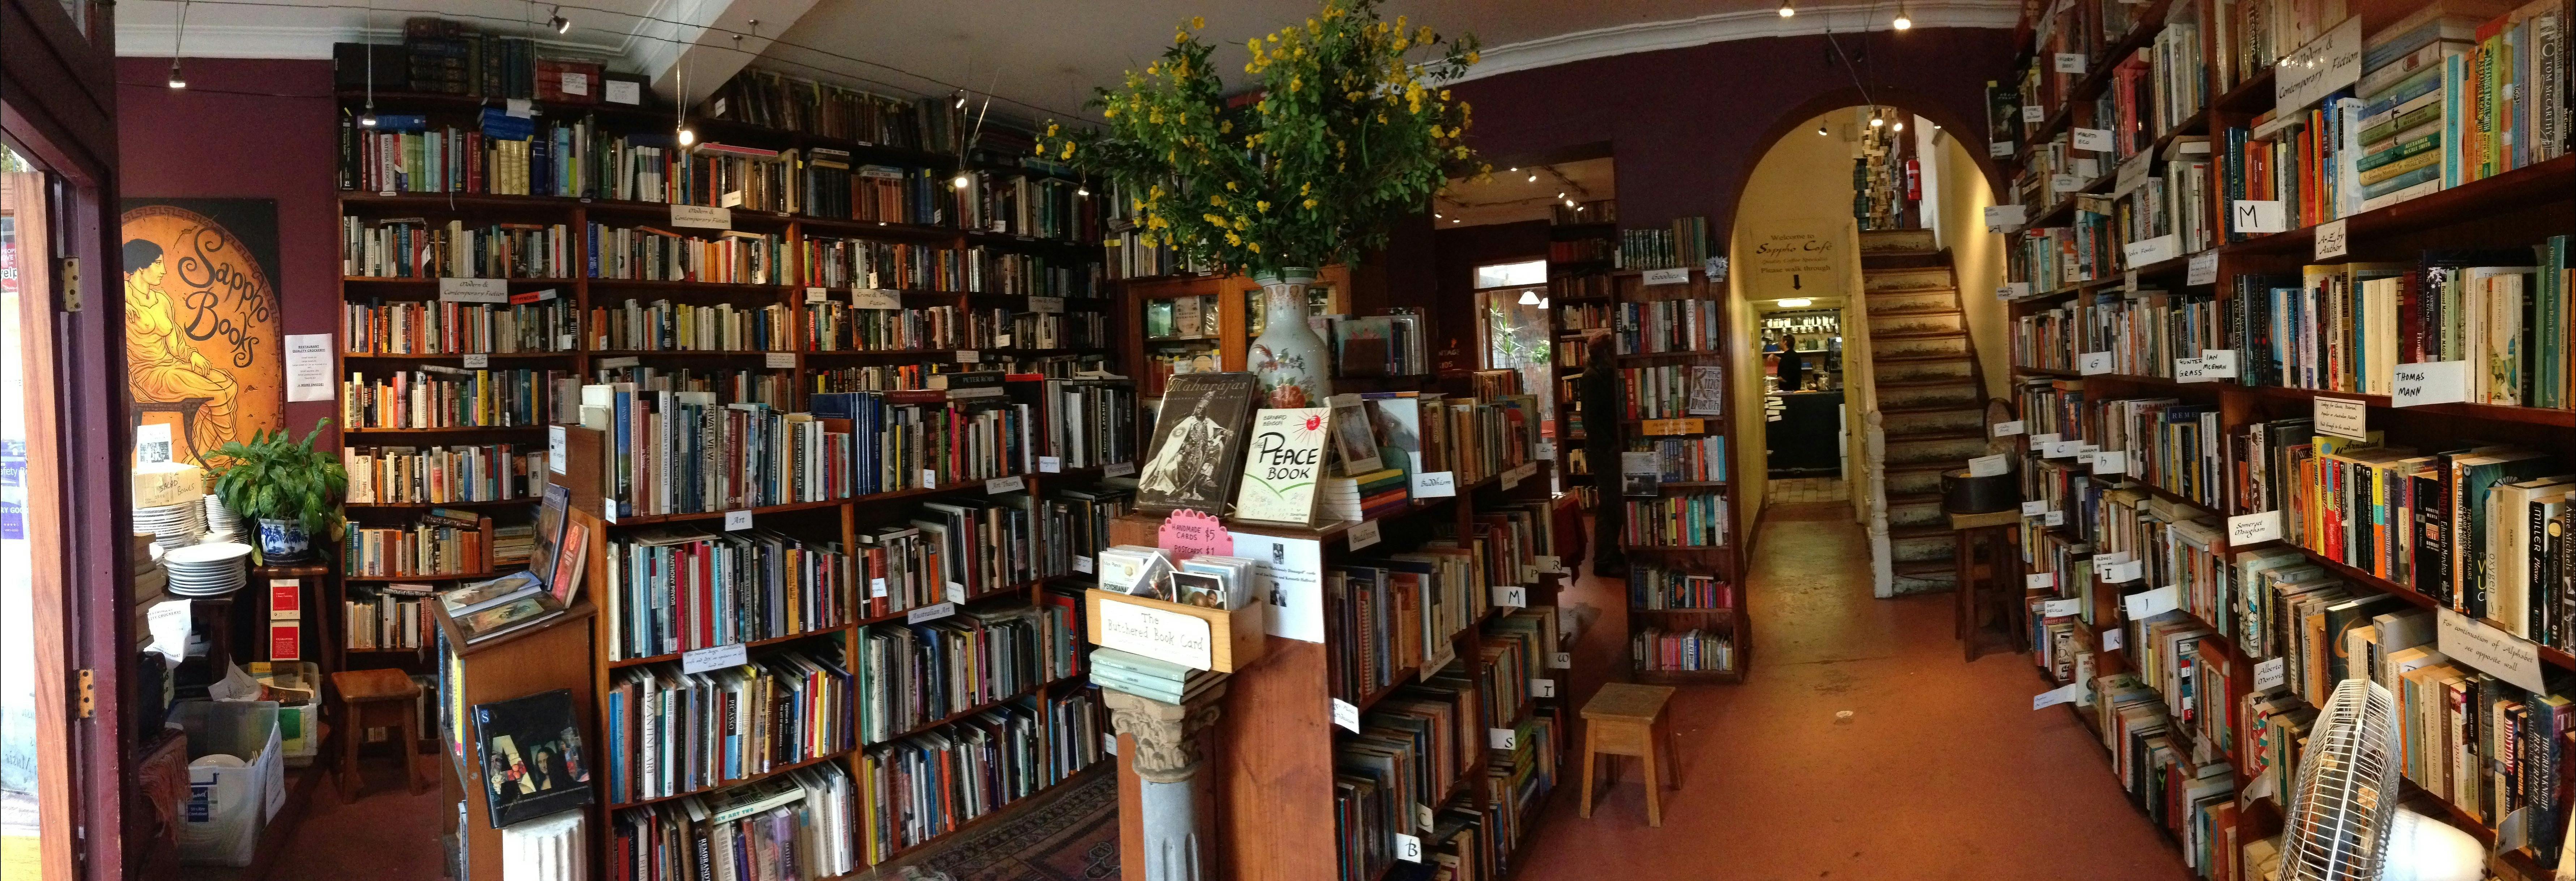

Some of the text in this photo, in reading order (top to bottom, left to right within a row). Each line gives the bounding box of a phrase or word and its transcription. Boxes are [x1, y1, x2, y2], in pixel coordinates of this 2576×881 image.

[2325, 35, 2333, 50] &
[2279, 51, 2359, 99] Contemporary Fiction
[2545, 85, 2554, 135] McCARTHY
[2239, 204, 2258, 228] M
[2337, 227, 2344, 244] by
[1756, 240, 1833, 257] Sappho Café
[2320, 243, 2342, 255] Author
[178, 227, 269, 328] Sappho
[1651, 271, 1679, 281] Goodies
[444, 289, 485, 299] Contemporary
[184, 287, 259, 368] Books
[2396, 372, 2424, 382] THOMAS
[2398, 386, 2421, 396] MANN
[2326, 422, 2334, 430] through
[1259, 432, 1319, 465] PEACE
[2343, 437, 2380, 450] Armistead
[1266, 467, 1310, 480] BOOK
[159, 480, 178, 493] SALAD
[992, 480, 1019, 490] Art Theory
[1420, 477, 1452, 488] Buddhism
[178, 483, 194, 495] BOWLS
[2236, 520, 2264, 529] Somerset
[1172, 524, 1215, 541] HANDMADE $5
[1176, 532, 1198, 540] CARDS
[2235, 527, 2265, 538] Maugham
[1174, 545, 1215, 556] POSTCARDS $1
[1552, 560, 1562, 571] R
[1530, 568, 1538, 578] P
[2104, 568, 2112, 579] I
[1508, 590, 1519, 604] M
[2144, 599, 2149, 611] J
[910, 610, 940, 621] Australian
[1141, 613, 1159, 624] The
[1108, 619, 1203, 651] Butchered Book Card
[2443, 619, 2533, 663] For continuation of Alphabet
[2476, 650, 2500, 664] opposite
[2504, 662, 2517, 671] wall
[2257, 664, 2282, 675] Alberto
[2257, 672, 2283, 685] Moravia
[1504, 737, 1513, 748] S
[1418, 812, 1430, 827] C
[1407, 839, 1419, 857] B
